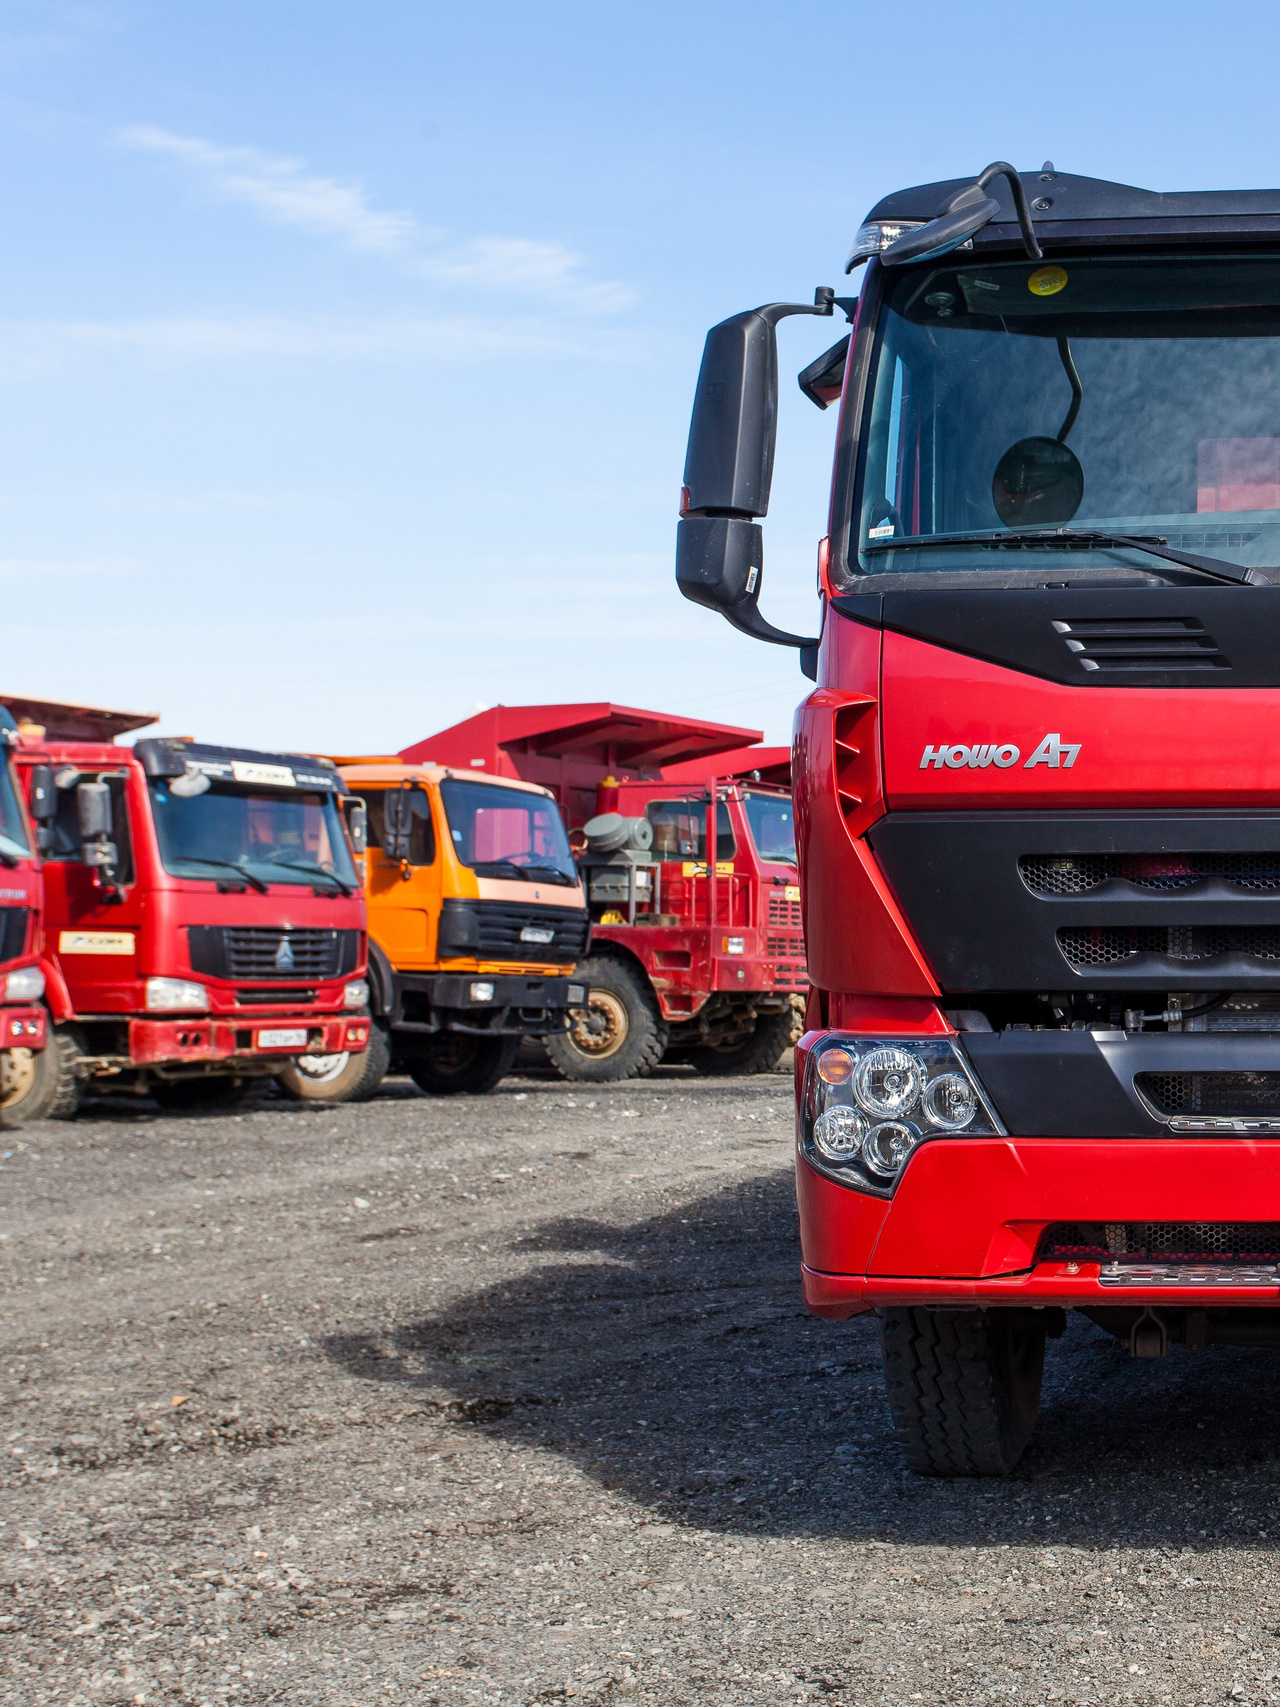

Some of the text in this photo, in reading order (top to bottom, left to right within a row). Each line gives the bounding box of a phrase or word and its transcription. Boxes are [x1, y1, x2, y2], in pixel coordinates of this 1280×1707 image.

[1038, 278, 1061, 291] 2013
[918, 733, 1082, 769] HOWO A7
